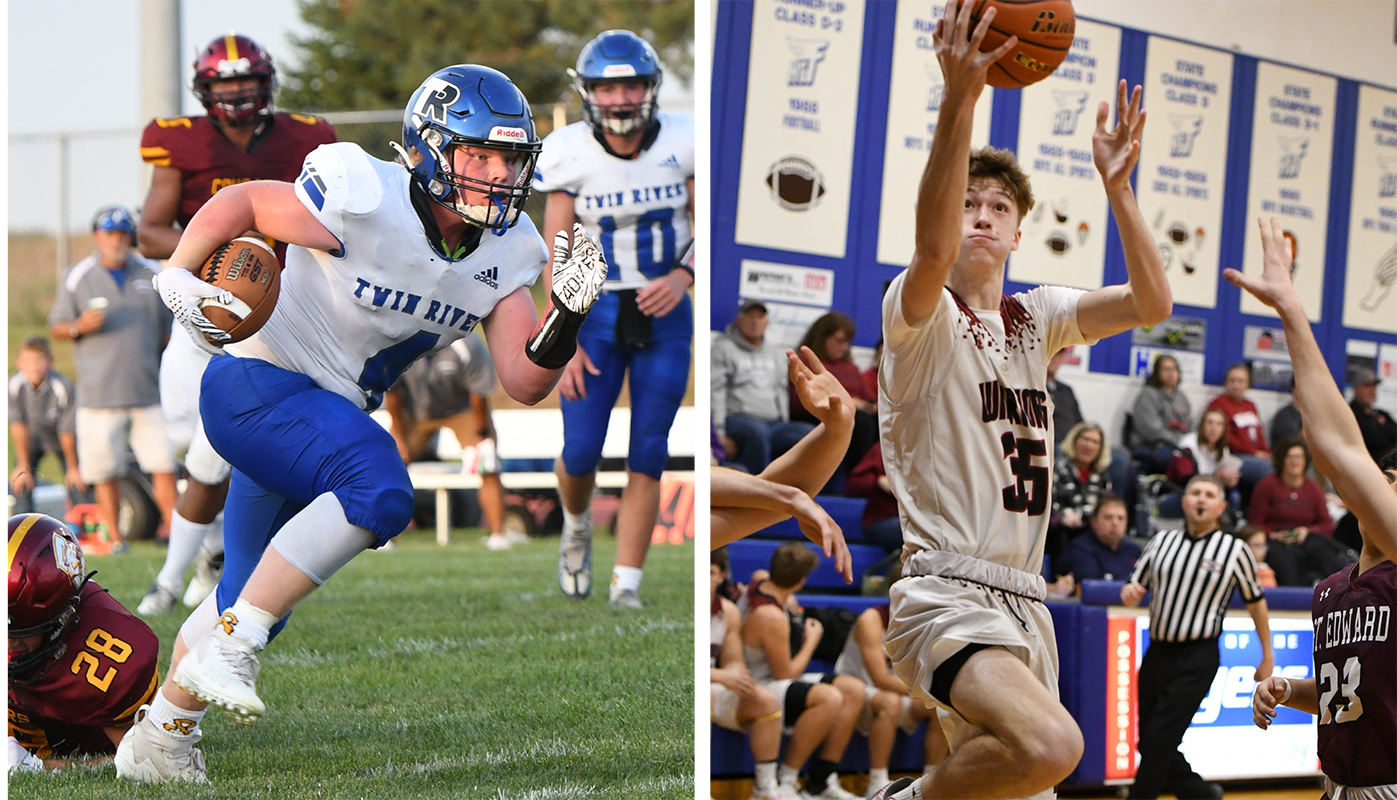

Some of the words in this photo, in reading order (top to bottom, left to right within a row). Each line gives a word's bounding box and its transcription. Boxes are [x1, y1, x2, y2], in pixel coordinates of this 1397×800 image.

[775, 7, 816, 26] CLASS
[496, 128, 525, 139] Riddell
[586, 190, 624, 209] TWIN
[632, 183, 683, 204] RIVER
[598, 208, 677, 282] 10
[225, 248, 252, 281] Wilson
[249, 257, 264, 283] GST
[473, 273, 500, 290] adidas
[353, 277, 423, 315] TWIN
[423, 299, 482, 332] RIVE
[1000, 431, 1049, 517] 35
[1224, 633, 1251, 650] OF
[1325, 605, 1391, 649] EDWARD
[70, 628, 134, 693] 28
[1116, 630, 1131, 771] POSSESSION
[1318, 656, 1364, 726] 23
